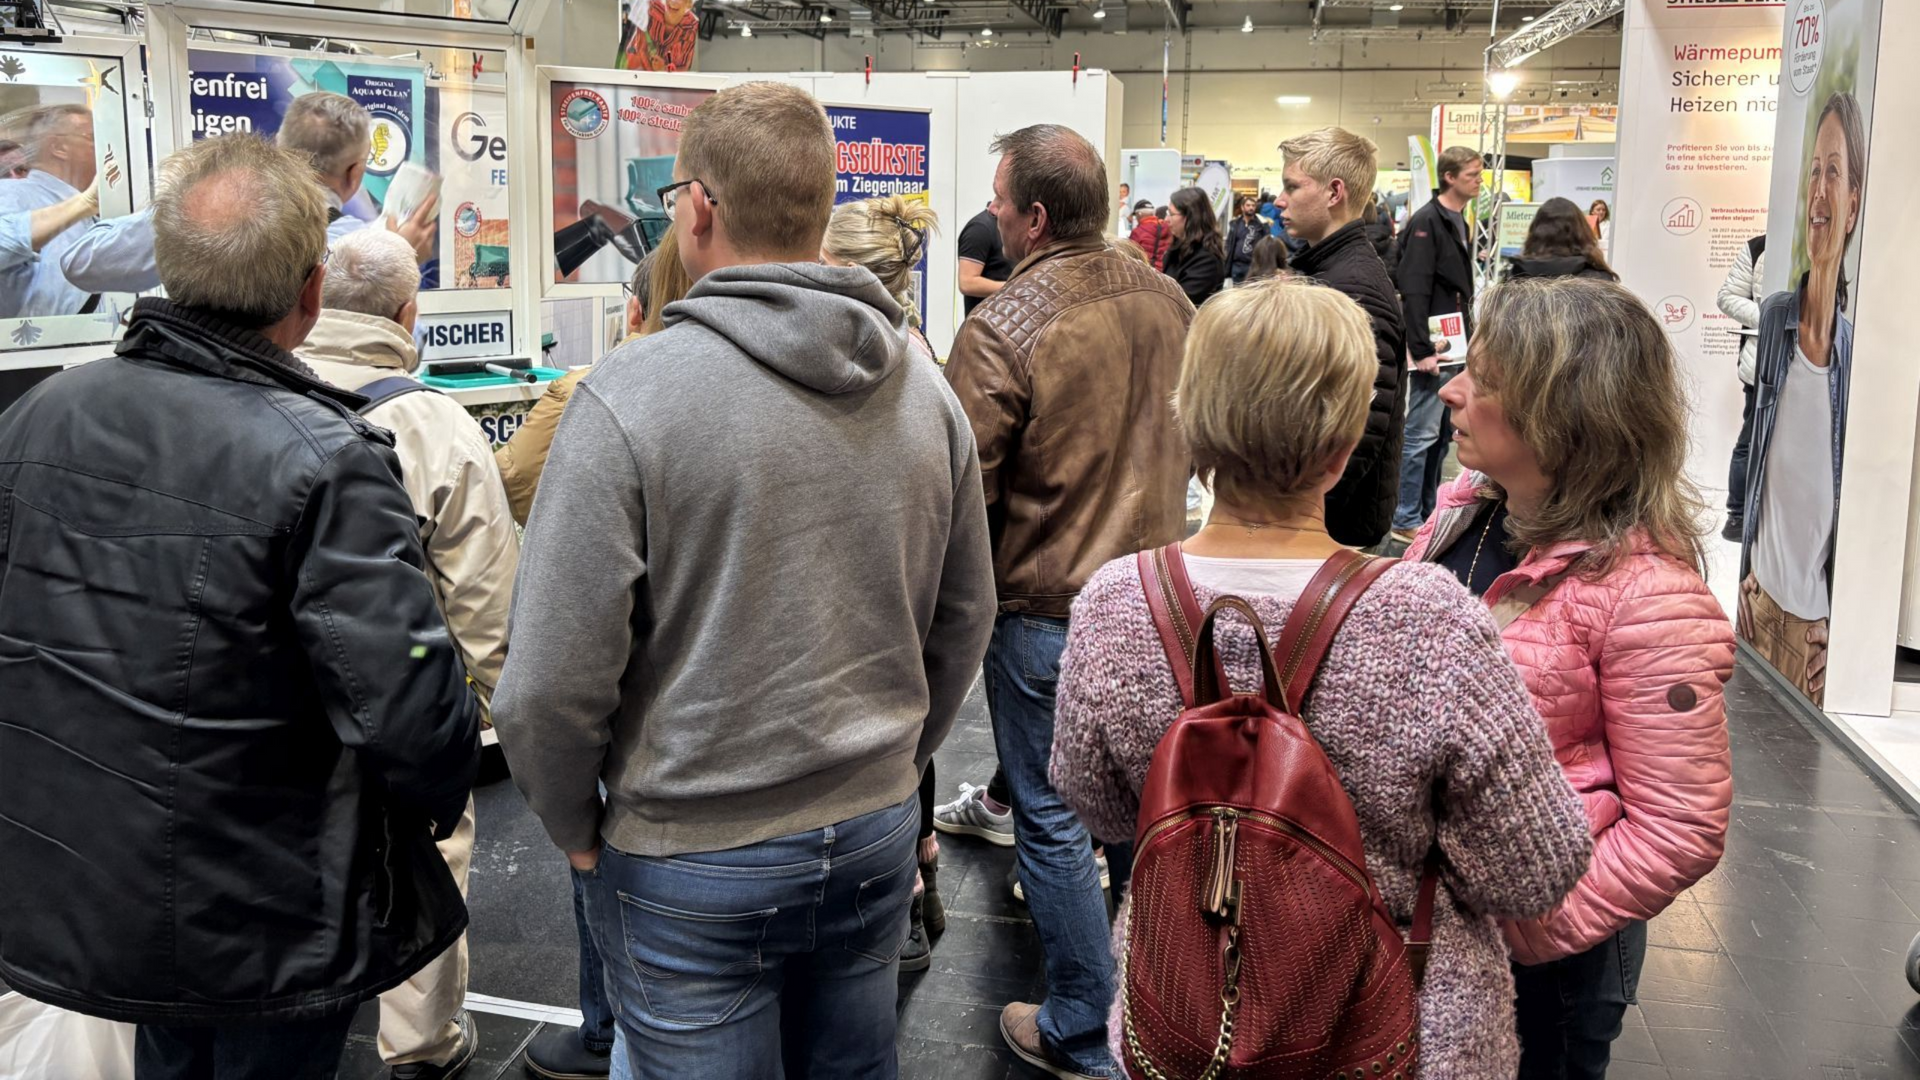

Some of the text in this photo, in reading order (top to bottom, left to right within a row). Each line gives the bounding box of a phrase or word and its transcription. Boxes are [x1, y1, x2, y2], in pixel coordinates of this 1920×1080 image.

[1796, 14, 1819, 49] 70%
[1674, 44, 1782, 63] Wärmepum
[188, 70, 268, 100] fenfrei
[365, 79, 395, 87] ORIGINAL
[1672, 70, 1760, 87] Sicherer
[352, 87, 374, 96] AQUA
[386, 104, 398, 113] mit
[630, 96, 661, 113] 100%
[1670, 96, 1777, 113] Heizen nic
[617, 108, 647, 125] 100%
[829, 115, 857, 130] UKTE
[451, 111, 508, 162] Ge
[836, 137, 926, 176] GSBÜRSTE
[1667, 144, 1712, 152] Profitieren
[1715, 144, 1727, 152] Sie
[1747, 144, 1761, 152] bis
[1667, 153, 1675, 161] in
[1698, 153, 1730, 161] sichere
[1733, 153, 1749, 161] und
[1665, 163, 1680, 171] Gas
[1697, 163, 1748, 171] investieren.
[491, 169, 507, 186] FE
[852, 176, 925, 197] Ziegenhaar
[428, 322, 505, 347] ISCHER
